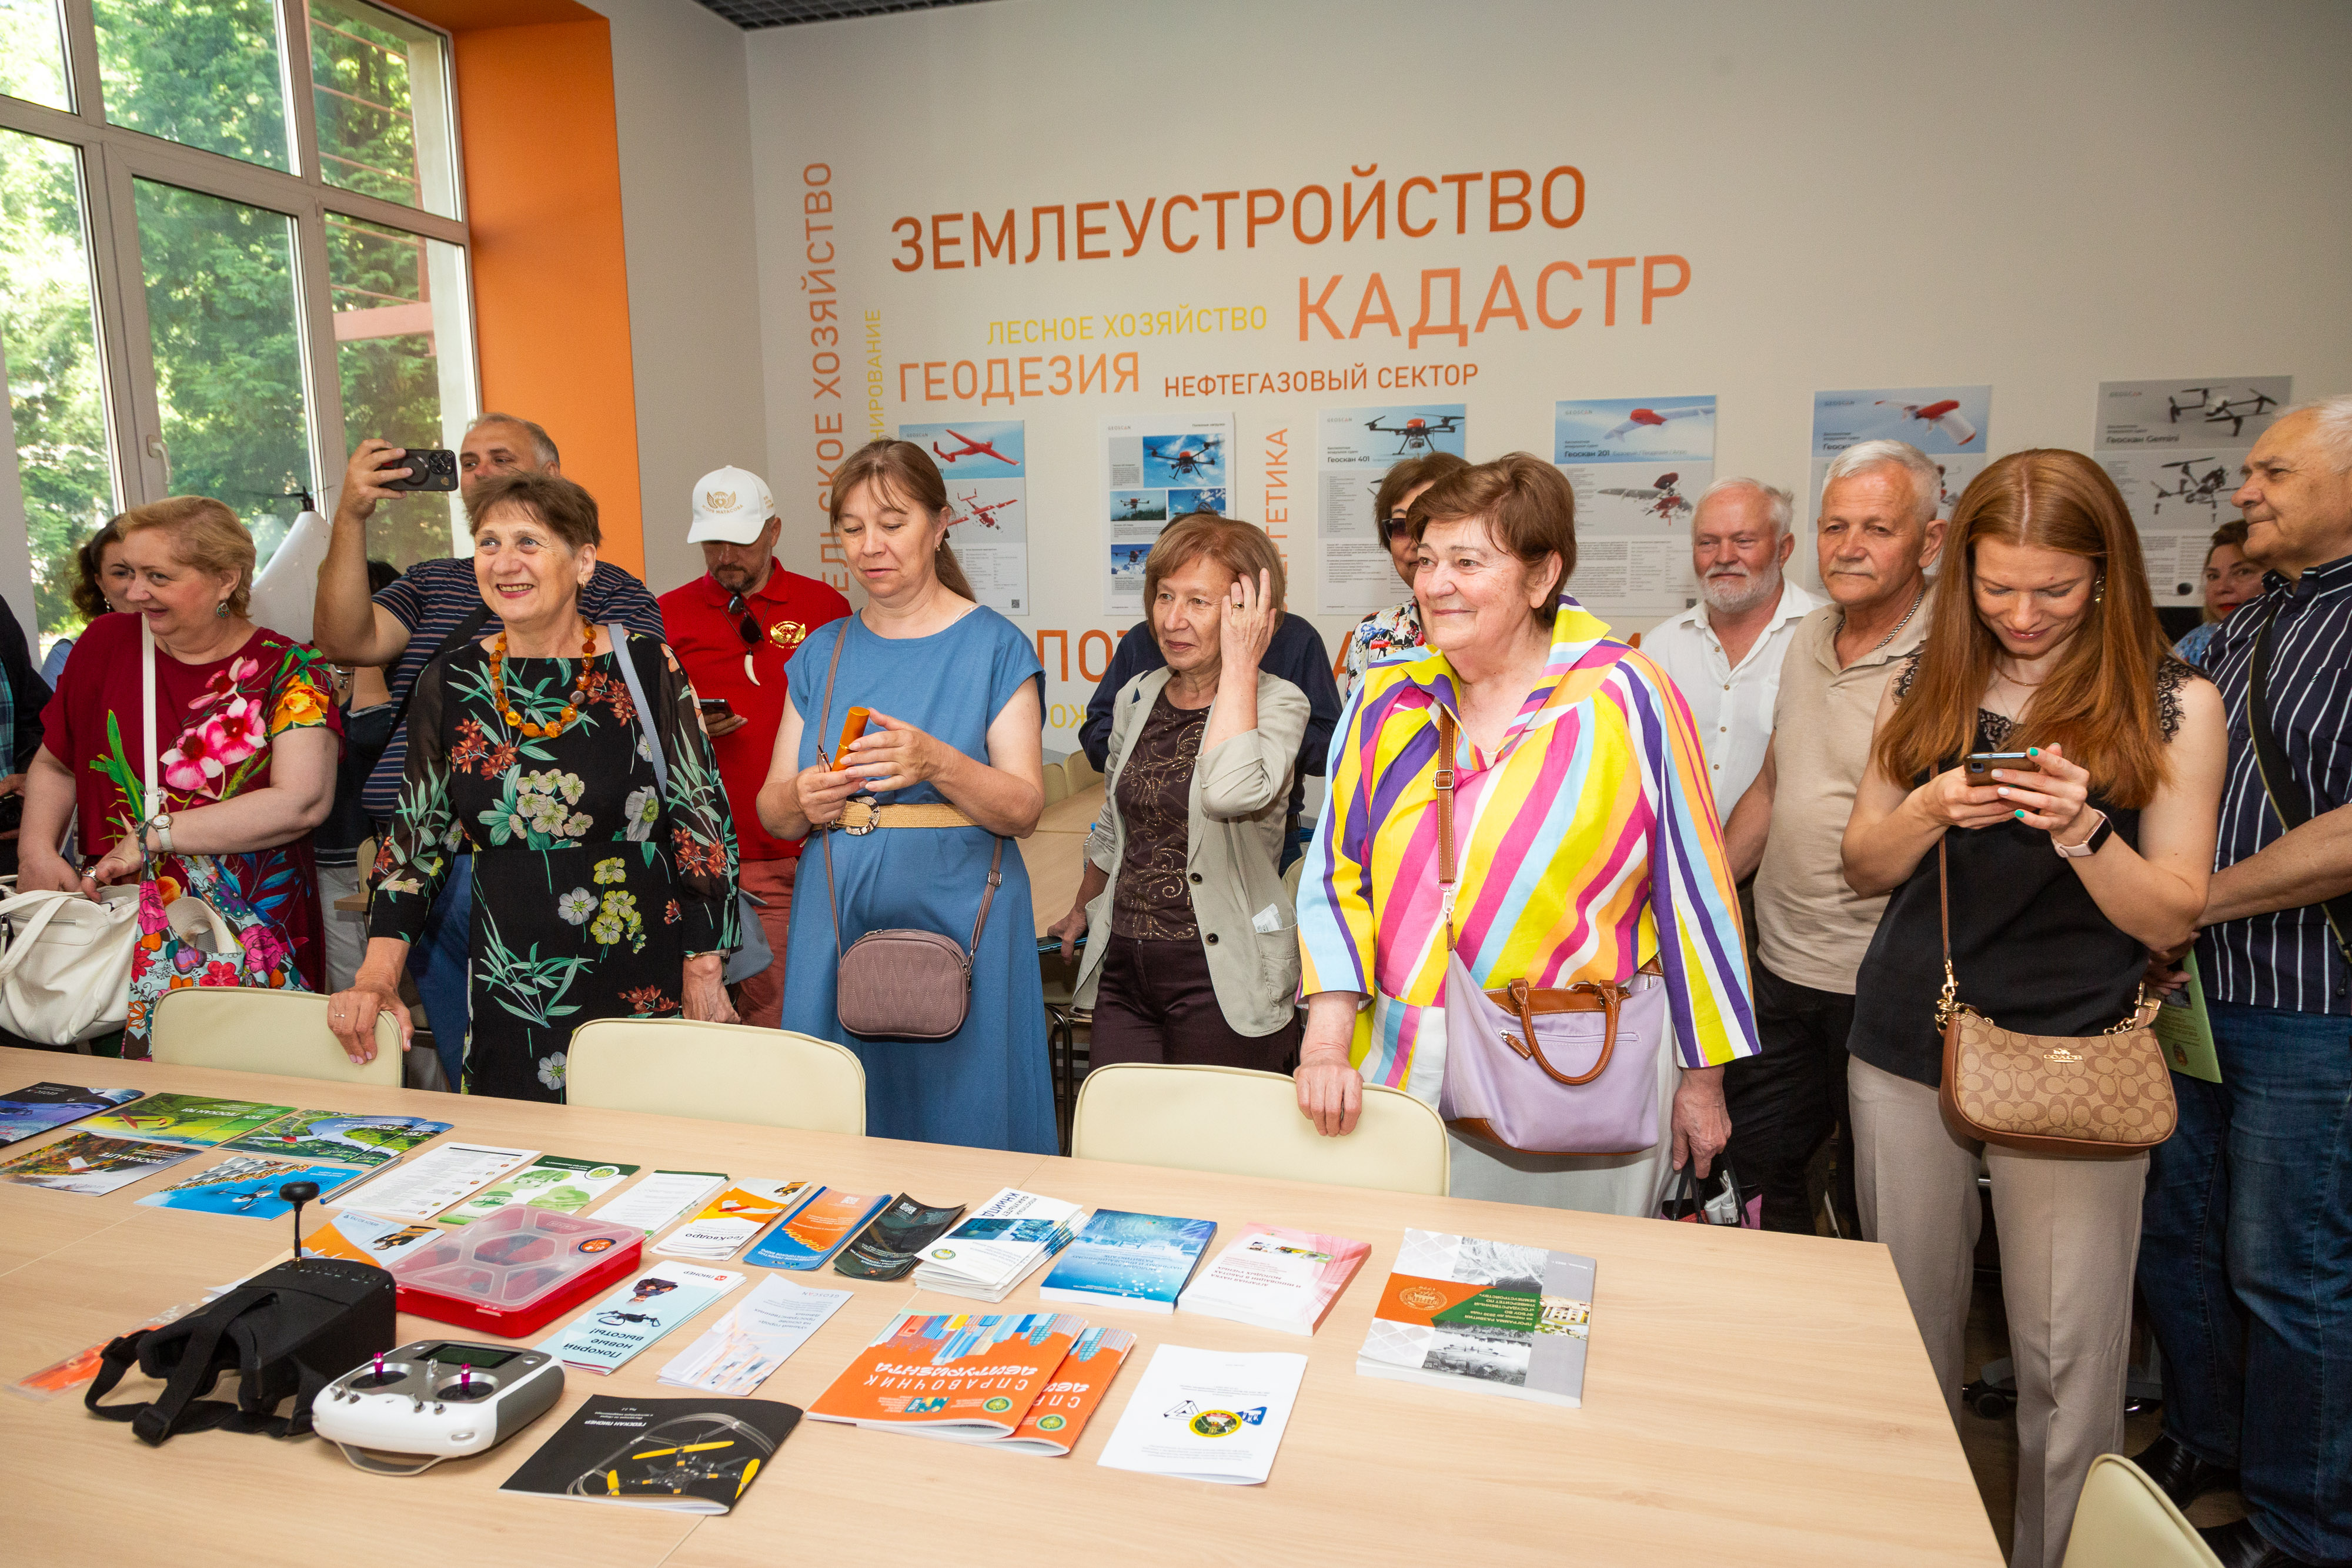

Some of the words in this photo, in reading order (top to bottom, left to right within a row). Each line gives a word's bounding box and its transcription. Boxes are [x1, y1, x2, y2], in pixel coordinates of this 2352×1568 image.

[890, 163, 1586, 273] ЗЕМЛЕУСТРОЙСТВО
[801, 162, 842, 399] ХОЗЯЙСТВО
[1299, 254, 1692, 349] КАДАСТР
[987, 319, 1095, 346] ЛЕСНОЕ
[1103, 303, 1268, 338] ХОЗЯЙСТВО
[898, 351, 1140, 406] ГЕОДЕЗИЯ
[1164, 362, 1368, 398] НЕФТЕГАЗОВЫЙ
[1377, 363, 1478, 389] СЕКТОР
[120, 1155, 168, 1164] ГЕОСКАН
[1234, 1278, 1268, 1286] АГРАРНАЯ
[1474, 1302, 1535, 1312] «ГОСУДАРСТВЕННЫЙ
[754, 1308, 816, 1322] пространственных
[589, 1328, 644, 1341] высоты!
[562, 1343, 622, 1358] Покоряй
[590, 1339, 633, 1349] новые
[874, 1362, 1038, 1377] АБИТУРИЕНТА
[863, 1374, 1028, 1390] СПРАВОЧНИК
